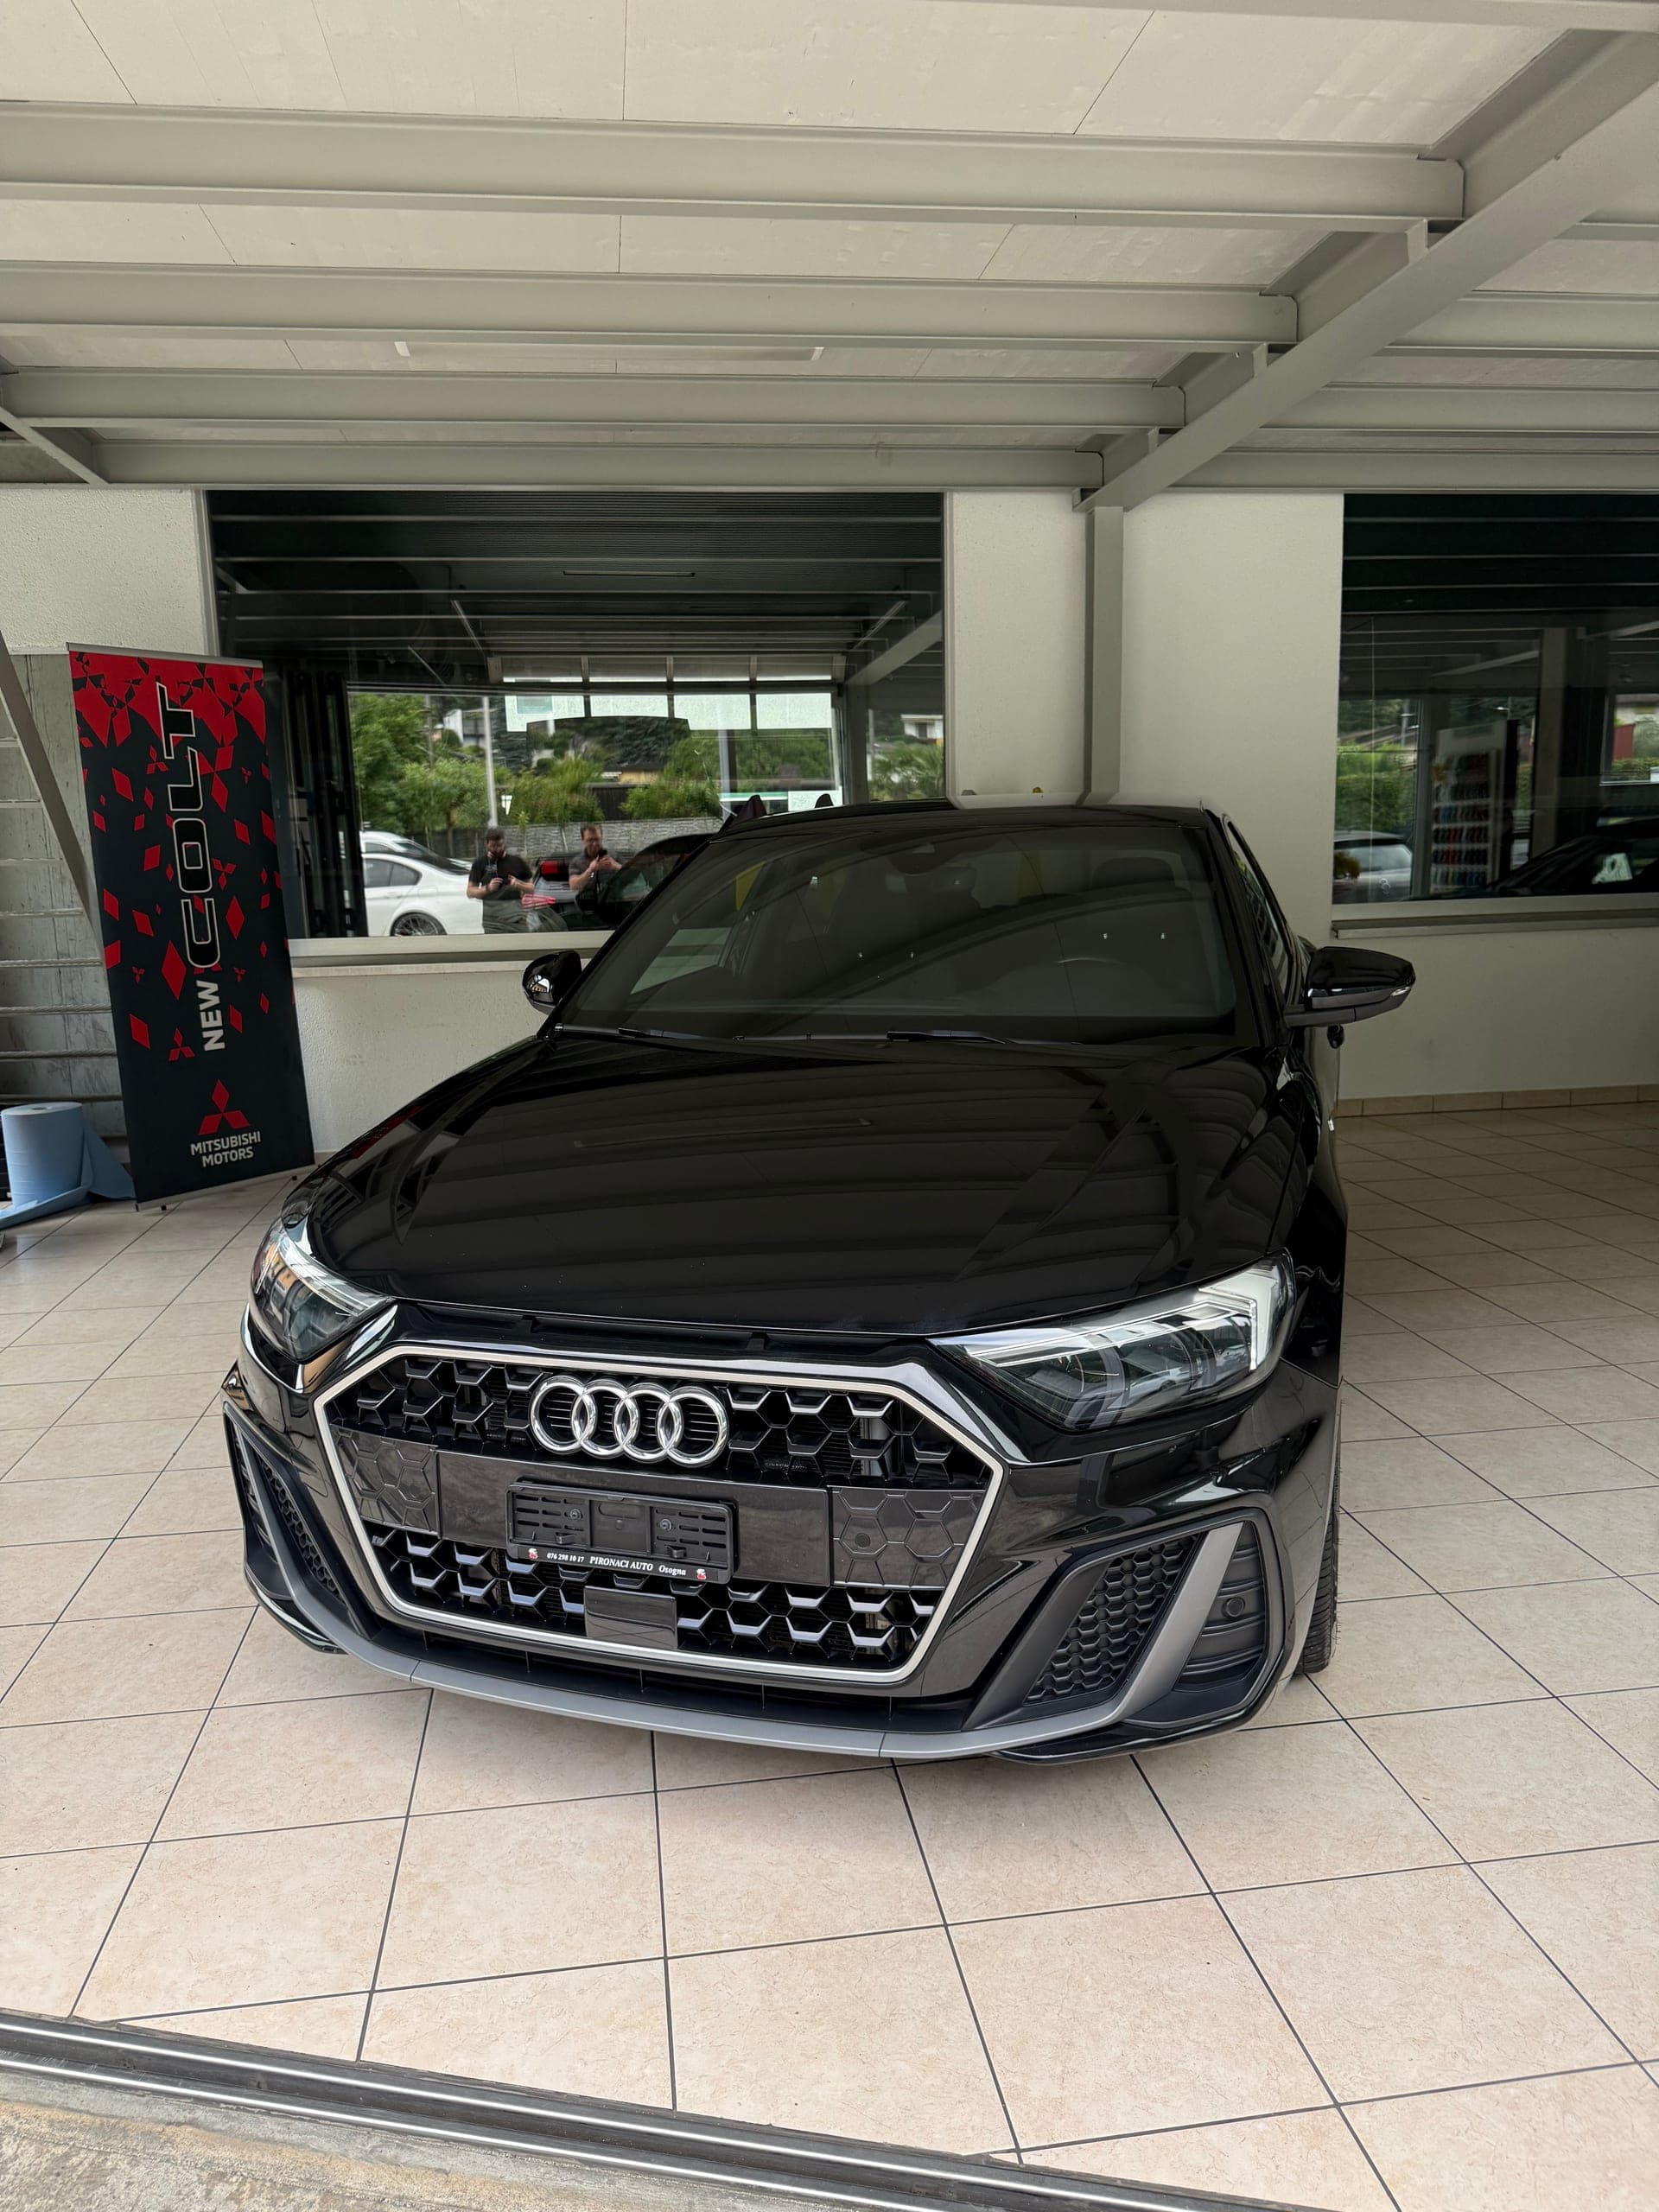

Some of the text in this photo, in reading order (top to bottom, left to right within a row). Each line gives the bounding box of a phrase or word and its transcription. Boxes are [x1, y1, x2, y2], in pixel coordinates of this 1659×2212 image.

[156, 681, 226, 1052] NEW COLT
[190, 1130, 261, 1156] MITSUBISHI
[201, 1146, 254, 1168] MOTORS
[546, 1552, 558, 1560] 076
[589, 1555, 630, 1568] PIRONACI
[629, 1561, 654, 1572] AUTO
[658, 1564, 687, 1576] Osogna
